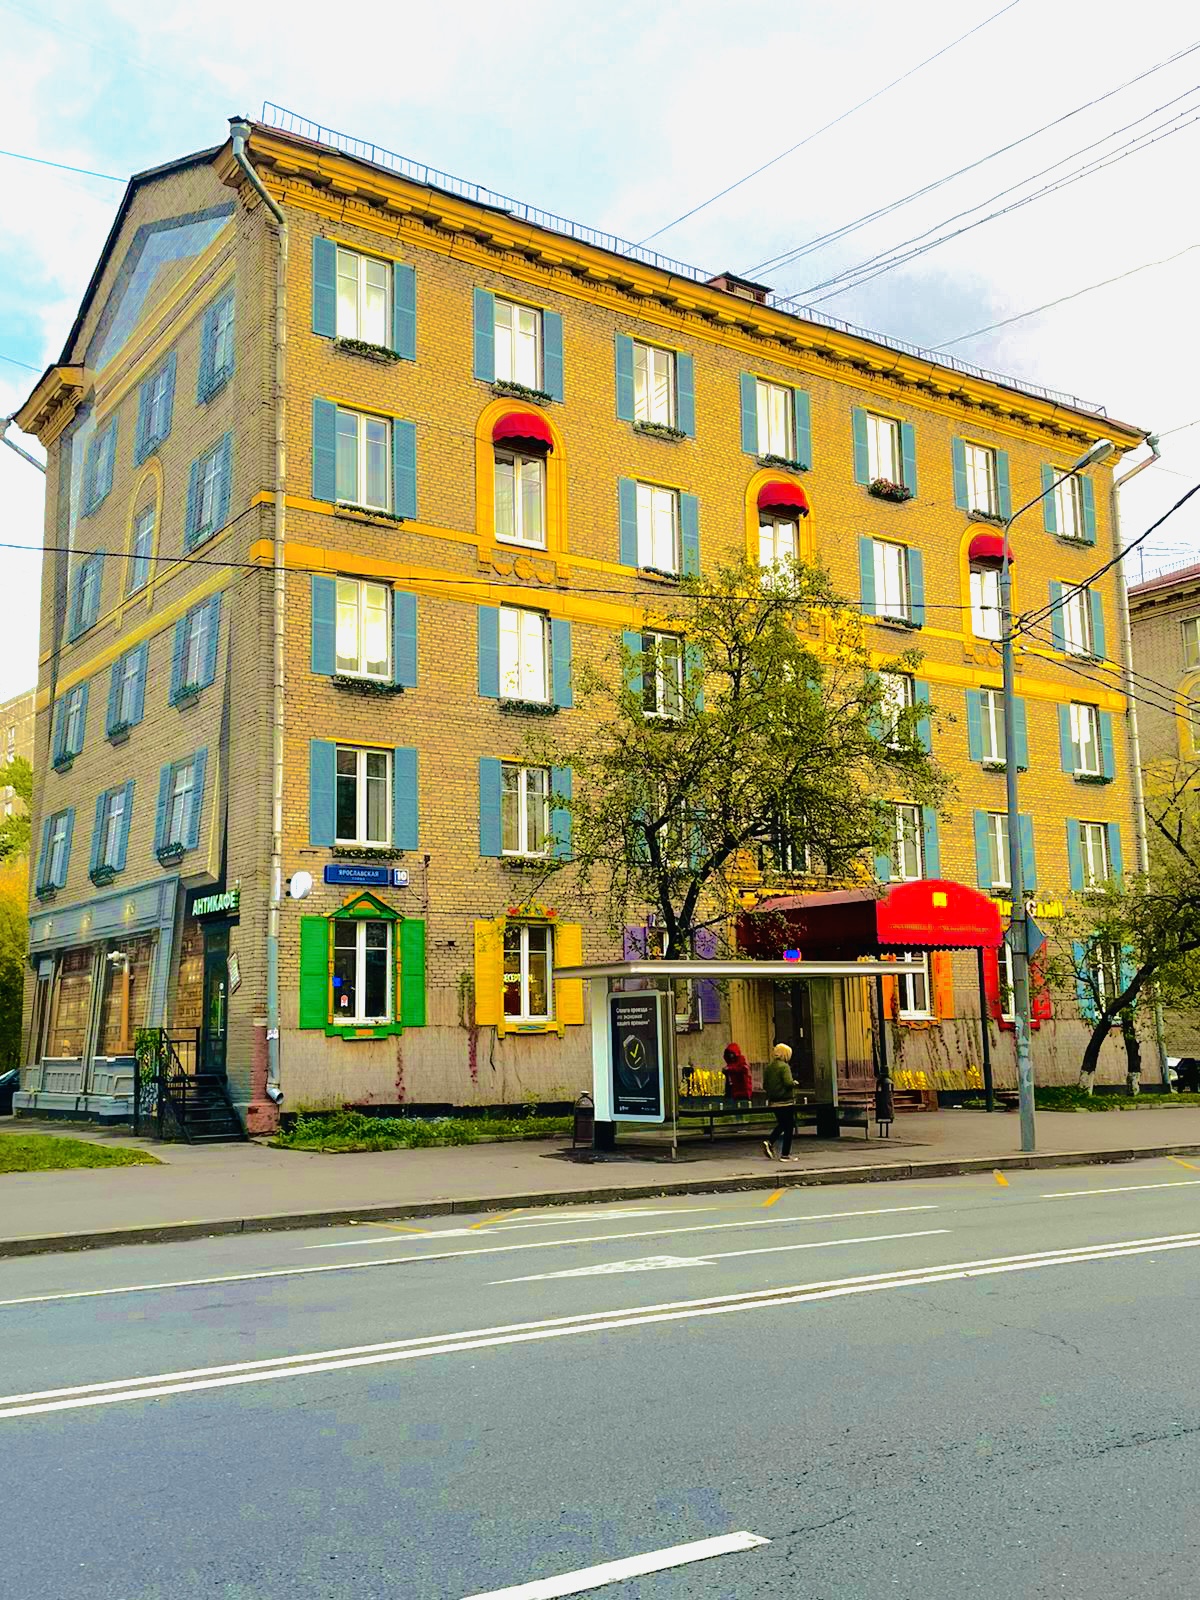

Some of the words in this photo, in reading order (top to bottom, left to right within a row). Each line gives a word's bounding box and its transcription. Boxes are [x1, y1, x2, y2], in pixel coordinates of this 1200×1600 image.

[338, 869, 380, 877] ЯРОСЛАВСКАЯ
[396, 871, 407, 881] 10
[191, 891, 238, 917] АНТИКАФЕ
